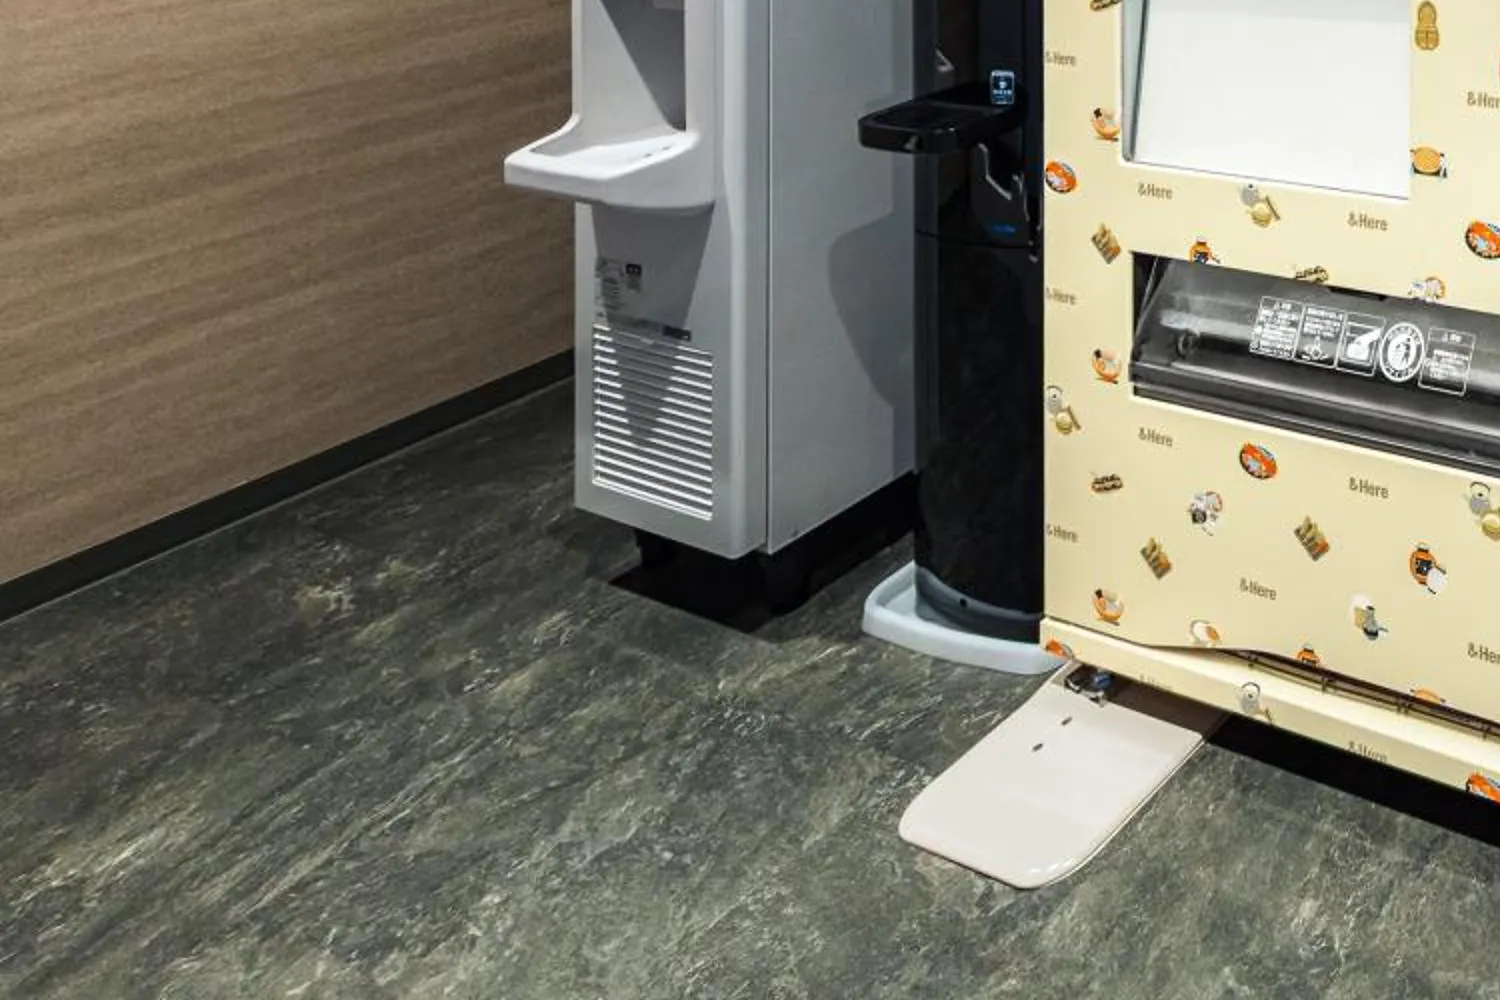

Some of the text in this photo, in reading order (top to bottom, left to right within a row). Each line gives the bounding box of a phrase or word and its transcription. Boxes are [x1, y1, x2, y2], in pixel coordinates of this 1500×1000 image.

[1137, 182, 1173, 200] &Here
[1348, 211, 1389, 232] &Here
[1138, 427, 1174, 448] &Here
[1348, 476, 1390, 499] &Here
[1238, 576, 1278, 601] &Here
